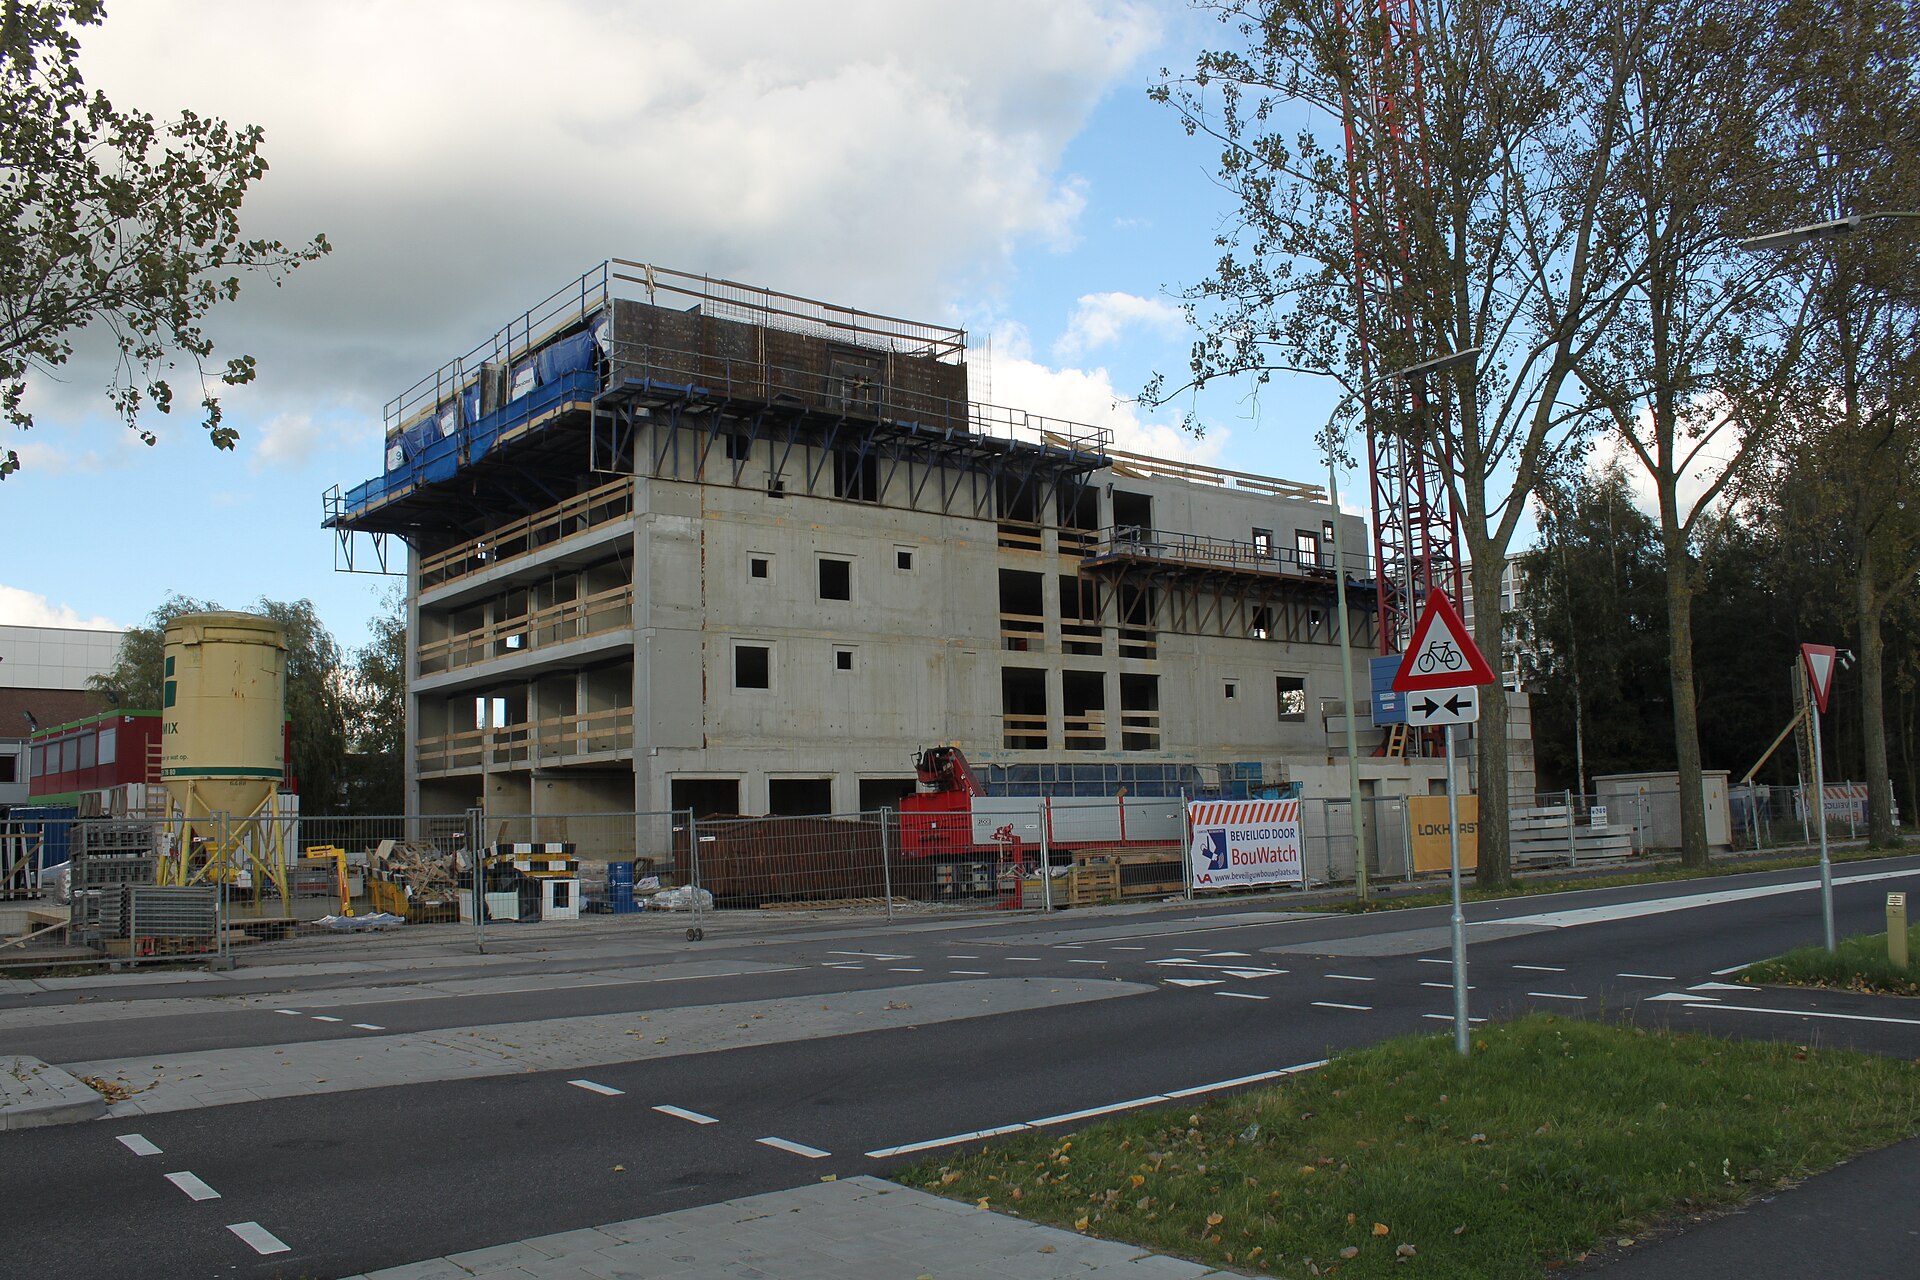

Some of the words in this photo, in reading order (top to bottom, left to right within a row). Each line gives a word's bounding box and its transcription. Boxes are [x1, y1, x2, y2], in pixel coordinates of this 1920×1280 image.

[1230, 829, 1271, 841] BEVEILIGD
[1272, 828, 1295, 839] DOOR
[1418, 822, 1479, 836] LOKHRS
[1231, 844, 1297, 866] BouWatch
[1214, 868, 1300, 882] www.beveiliguwbouwplaats.nu
